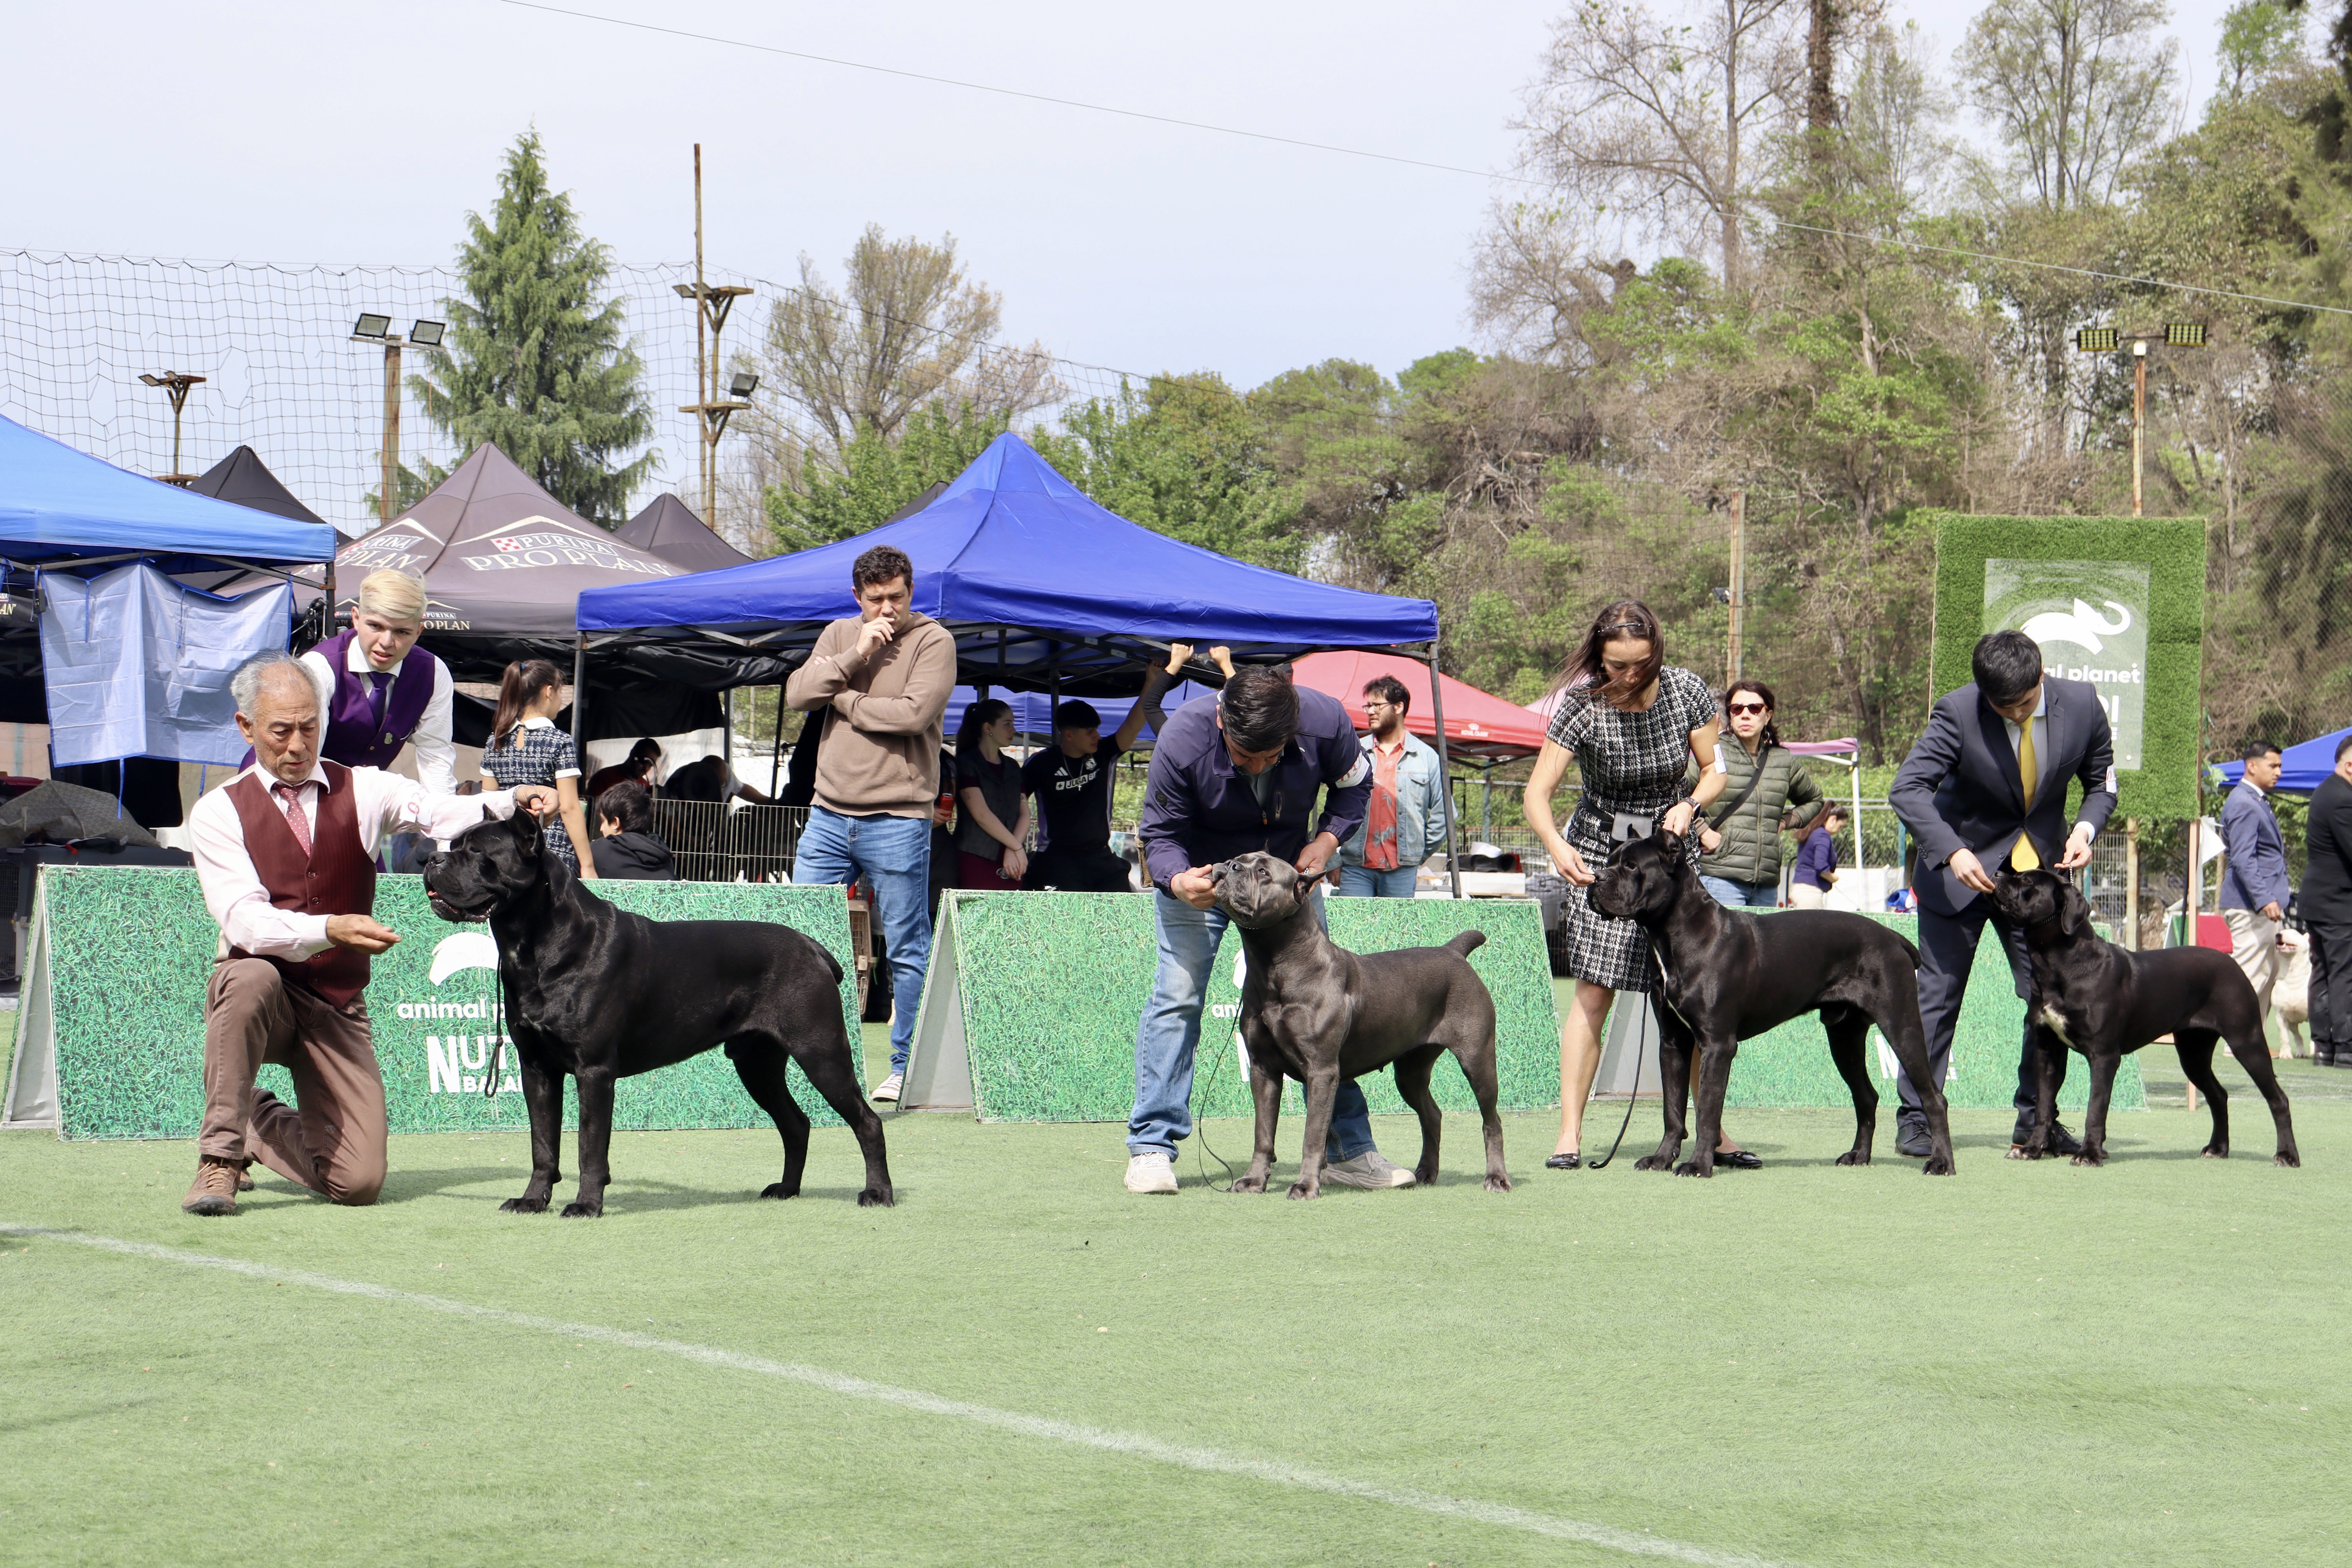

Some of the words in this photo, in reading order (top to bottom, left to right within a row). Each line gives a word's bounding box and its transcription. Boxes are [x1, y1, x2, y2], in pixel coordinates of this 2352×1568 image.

[519, 535, 609, 554] PURINA
[463, 550, 558, 571] PRO
[558, 548, 672, 577] PLAN
[435, 621, 470, 630] PLAN
[2068, 663, 2140, 684] planet
[397, 996, 486, 1019] animal
[426, 1035, 521, 1093] NUT
